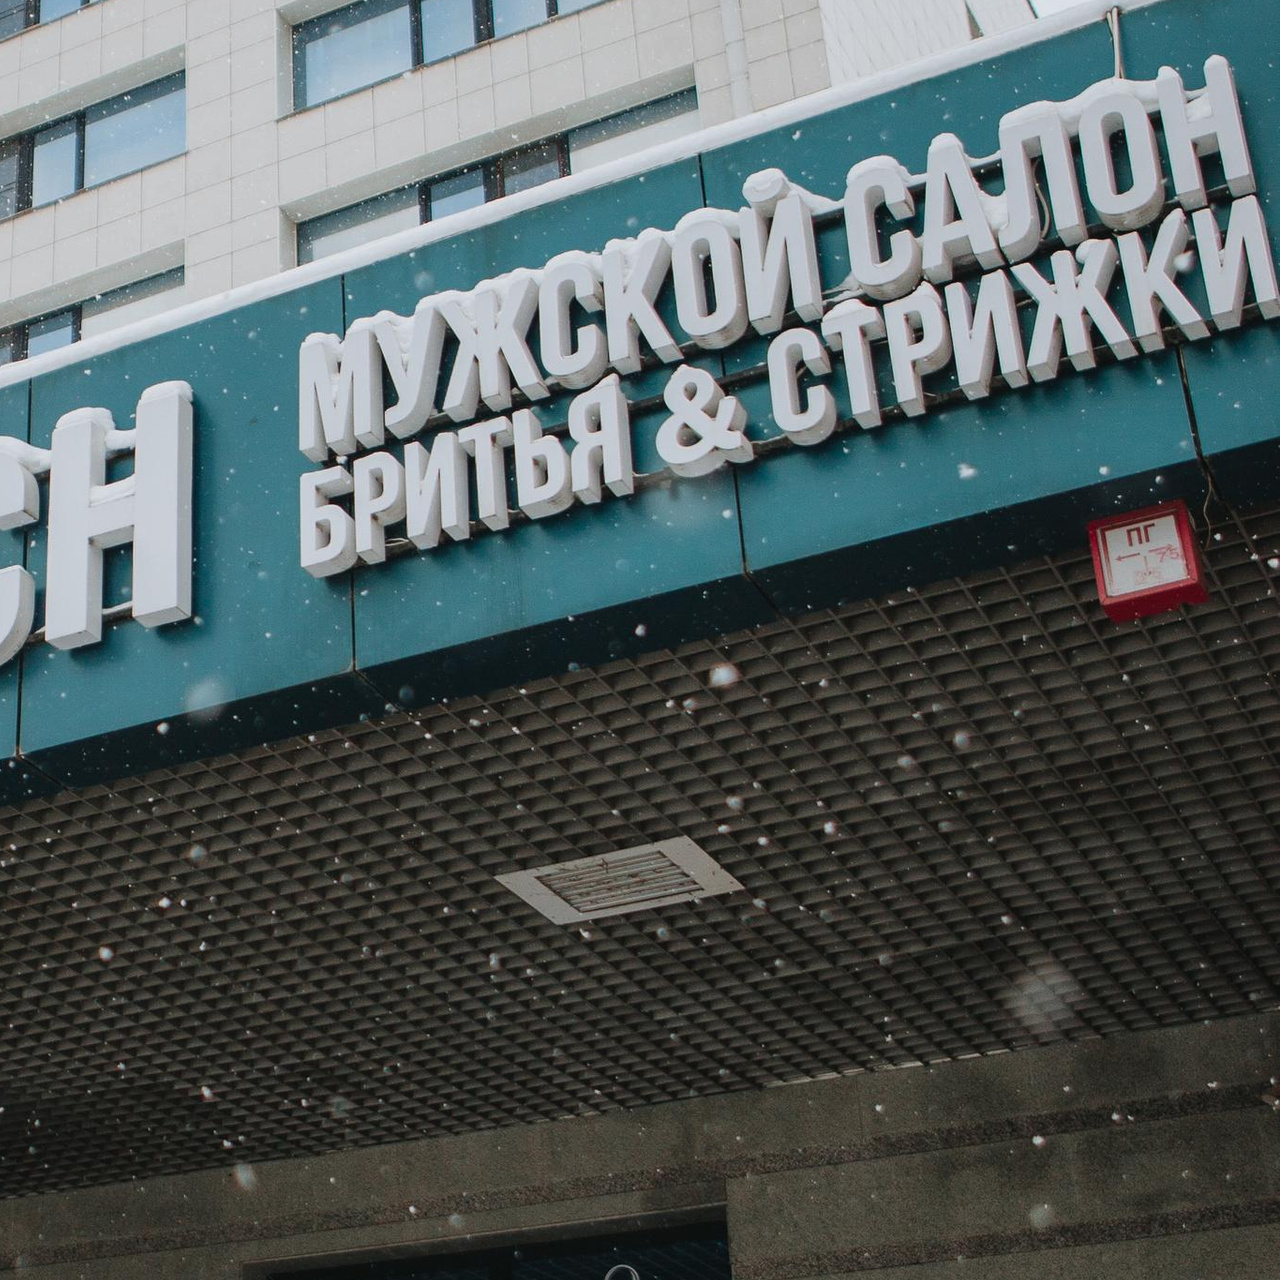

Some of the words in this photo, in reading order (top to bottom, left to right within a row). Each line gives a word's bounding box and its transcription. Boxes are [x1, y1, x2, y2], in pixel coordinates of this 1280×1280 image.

[299, 170, 823, 461] МУЖСКОЙ
[845, 55, 1257, 300] САЛОН
[299, 372, 634, 578] БРИТЬЯ
[656, 364, 754, 478] &
[768, 195, 1280, 445] СТРИЖКИ
[1126, 522, 1155, 547] ПГ
